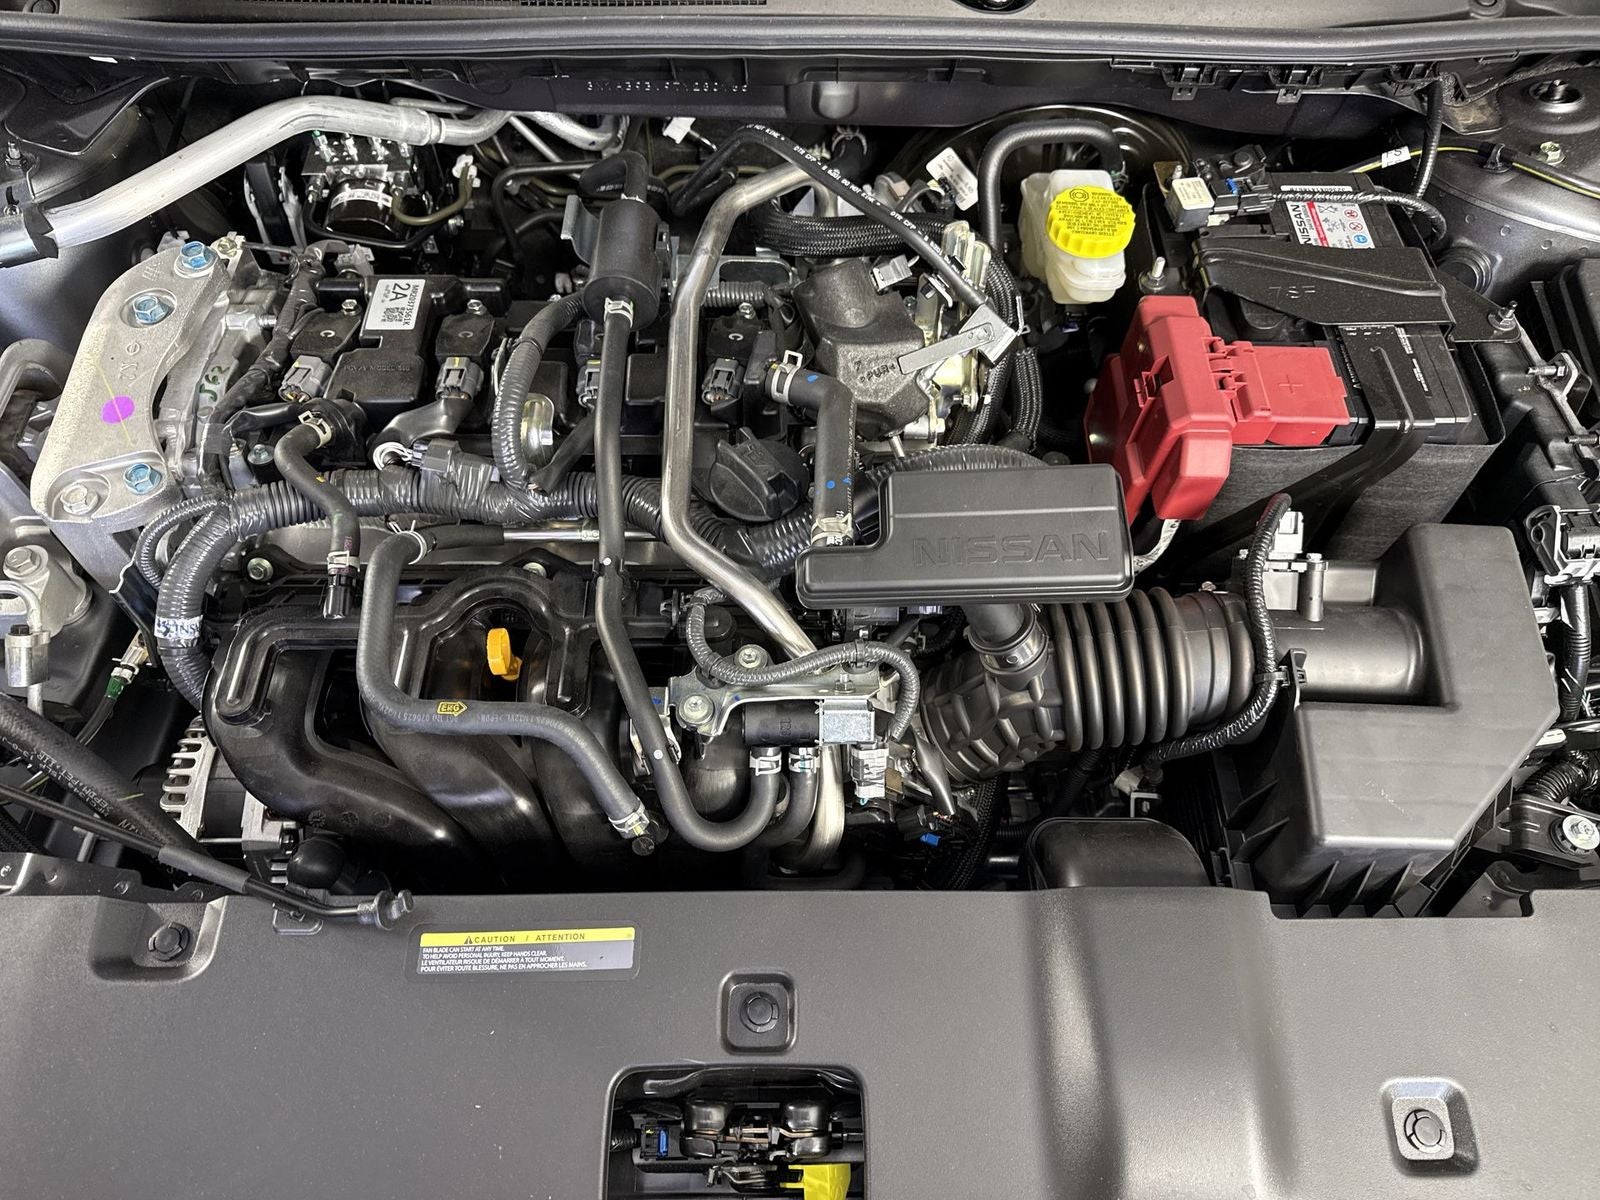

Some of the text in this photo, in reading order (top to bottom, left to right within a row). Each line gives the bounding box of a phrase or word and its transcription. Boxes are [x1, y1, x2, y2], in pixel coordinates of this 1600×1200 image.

[1290, 204, 1311, 244] NISSAN
[389, 283, 411, 302] 2A
[913, 530, 1109, 567] NISSAN
[536, 933, 585, 941] ATTENTION
